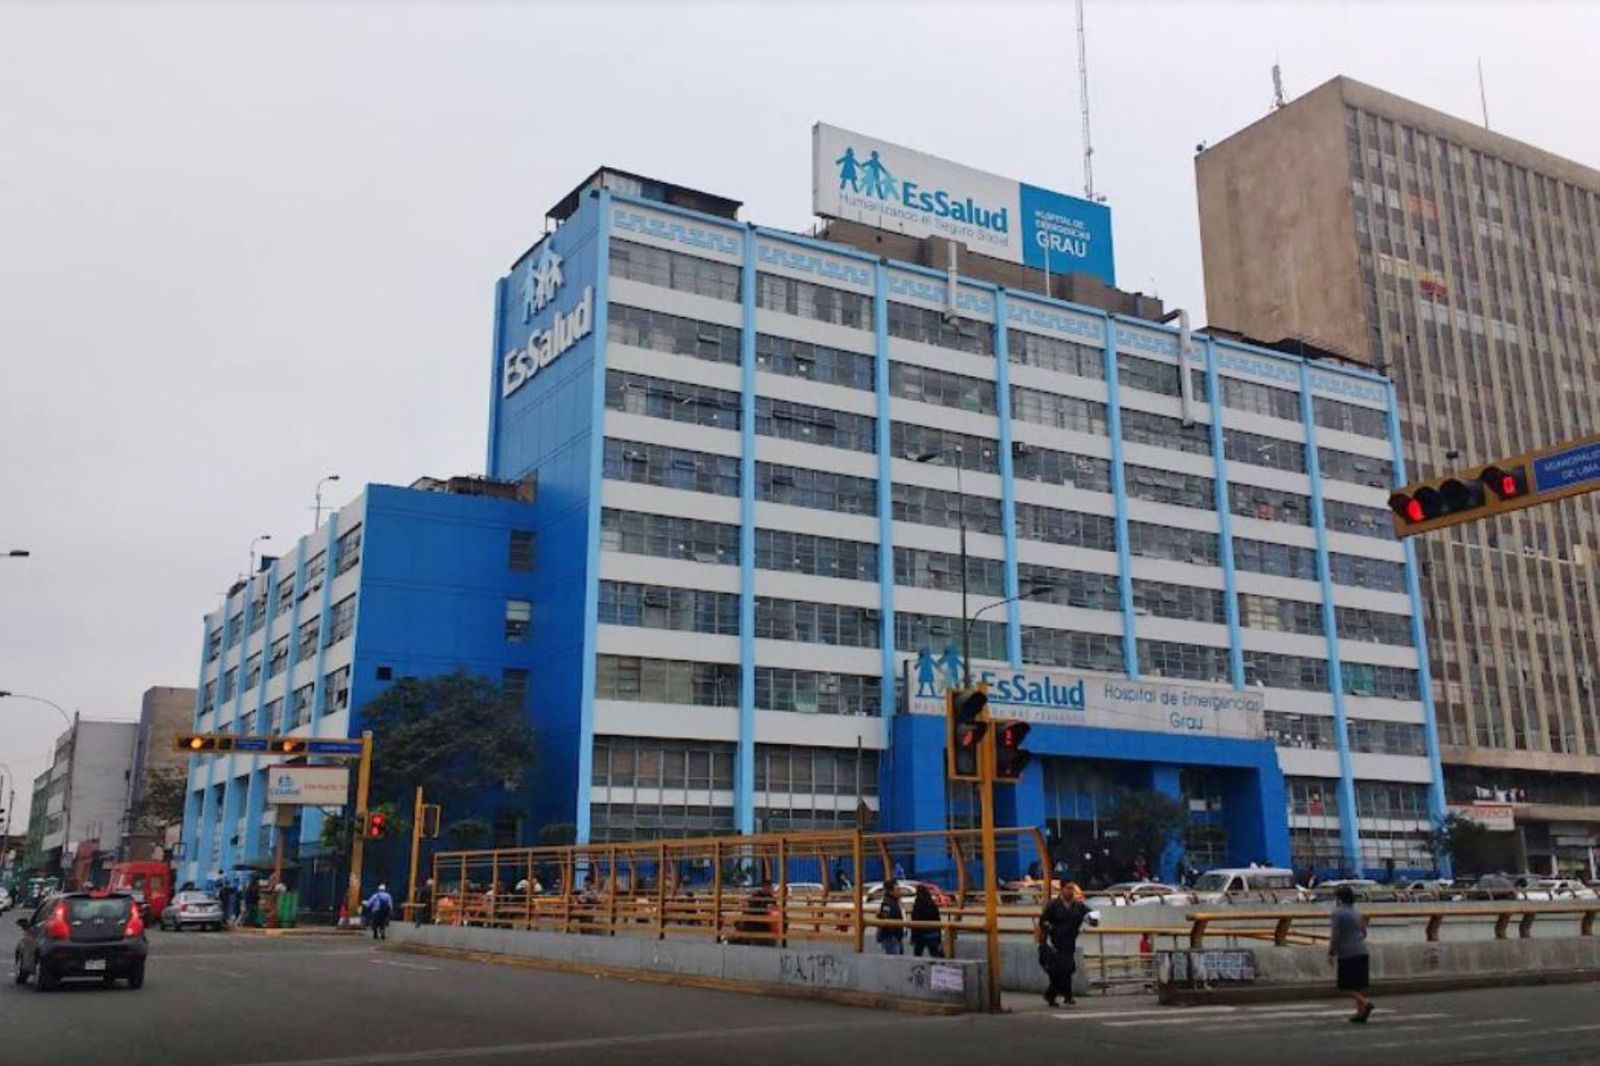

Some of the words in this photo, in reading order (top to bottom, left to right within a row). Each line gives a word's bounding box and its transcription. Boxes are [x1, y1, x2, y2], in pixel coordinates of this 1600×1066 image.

[903, 181, 1009, 233] EsSalud
[1036, 230, 1087, 258] GRAU
[502, 285, 593, 400] EsSalud
[981, 671, 1086, 708] EsSalud
[1104, 683, 1157, 703] Hospital
[1160, 689, 1177, 705] de
[1183, 690, 1259, 713] Emergencias
[1169, 711, 1204, 730] Grau
